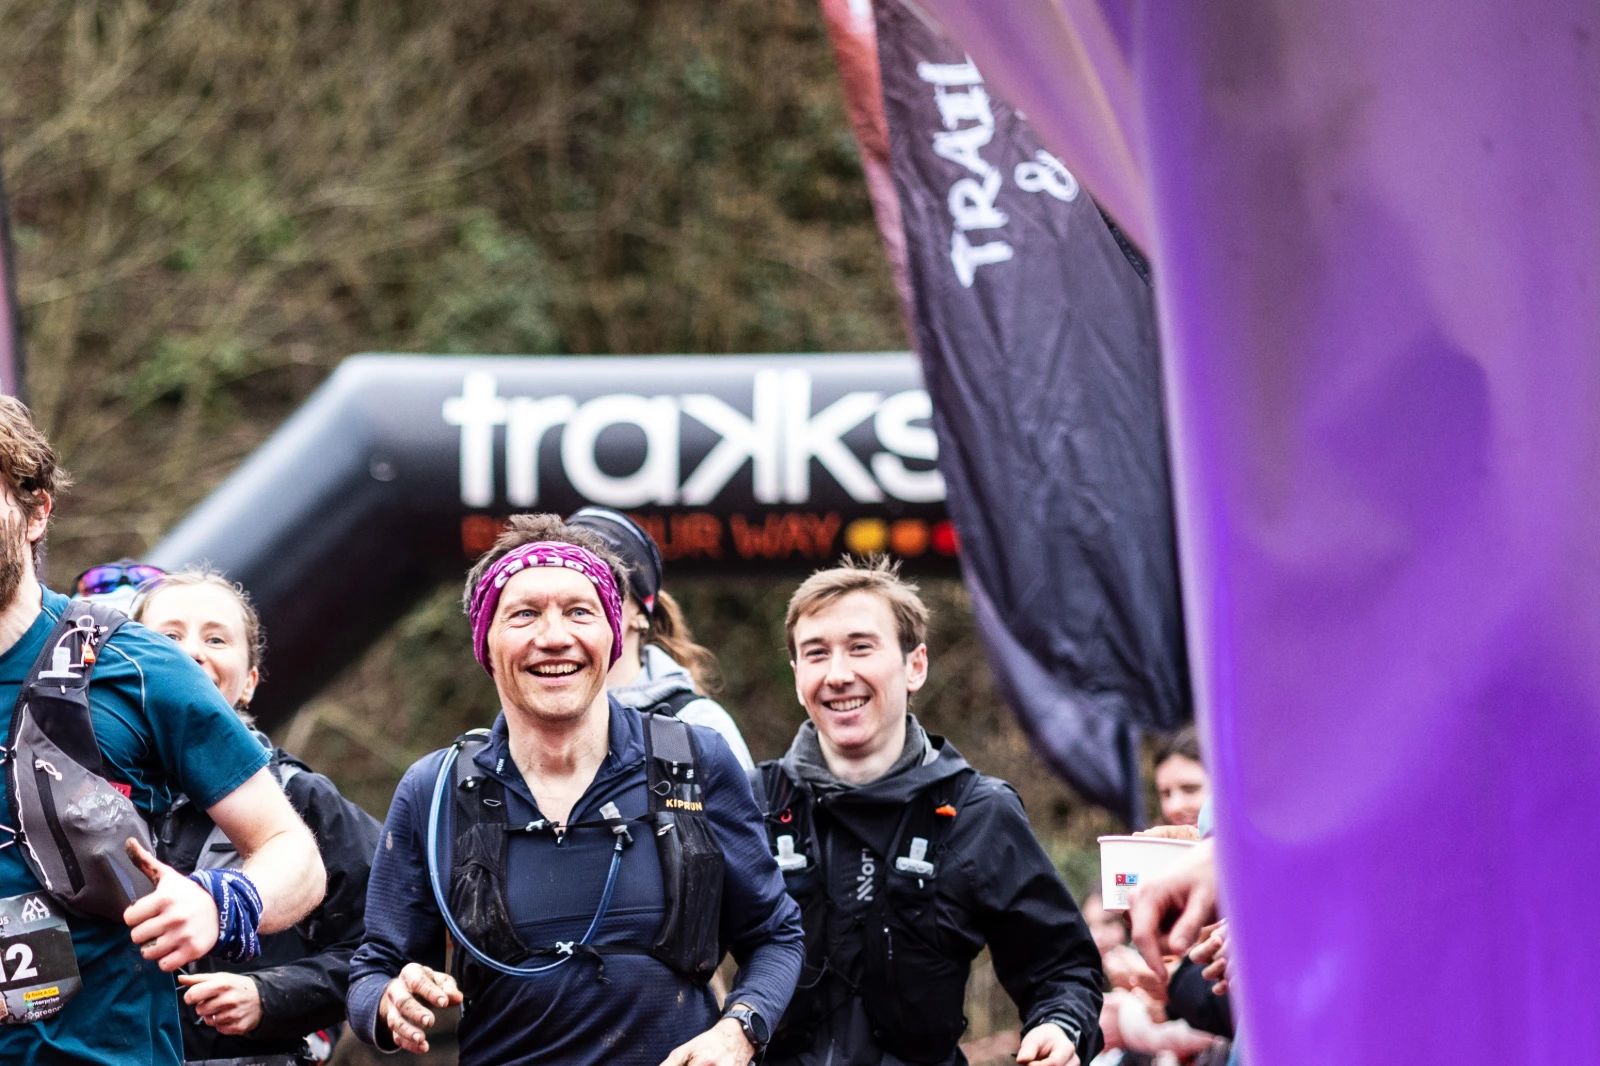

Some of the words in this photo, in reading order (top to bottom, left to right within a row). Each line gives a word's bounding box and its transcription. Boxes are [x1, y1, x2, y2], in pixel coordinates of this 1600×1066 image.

[918, 54, 1014, 288] TRAIL
[732, 512, 840, 560] WAY
[666, 797, 703, 812] KIPRUN
[856, 849, 875, 901] Nor
[22, 912, 51, 922] TDLS
